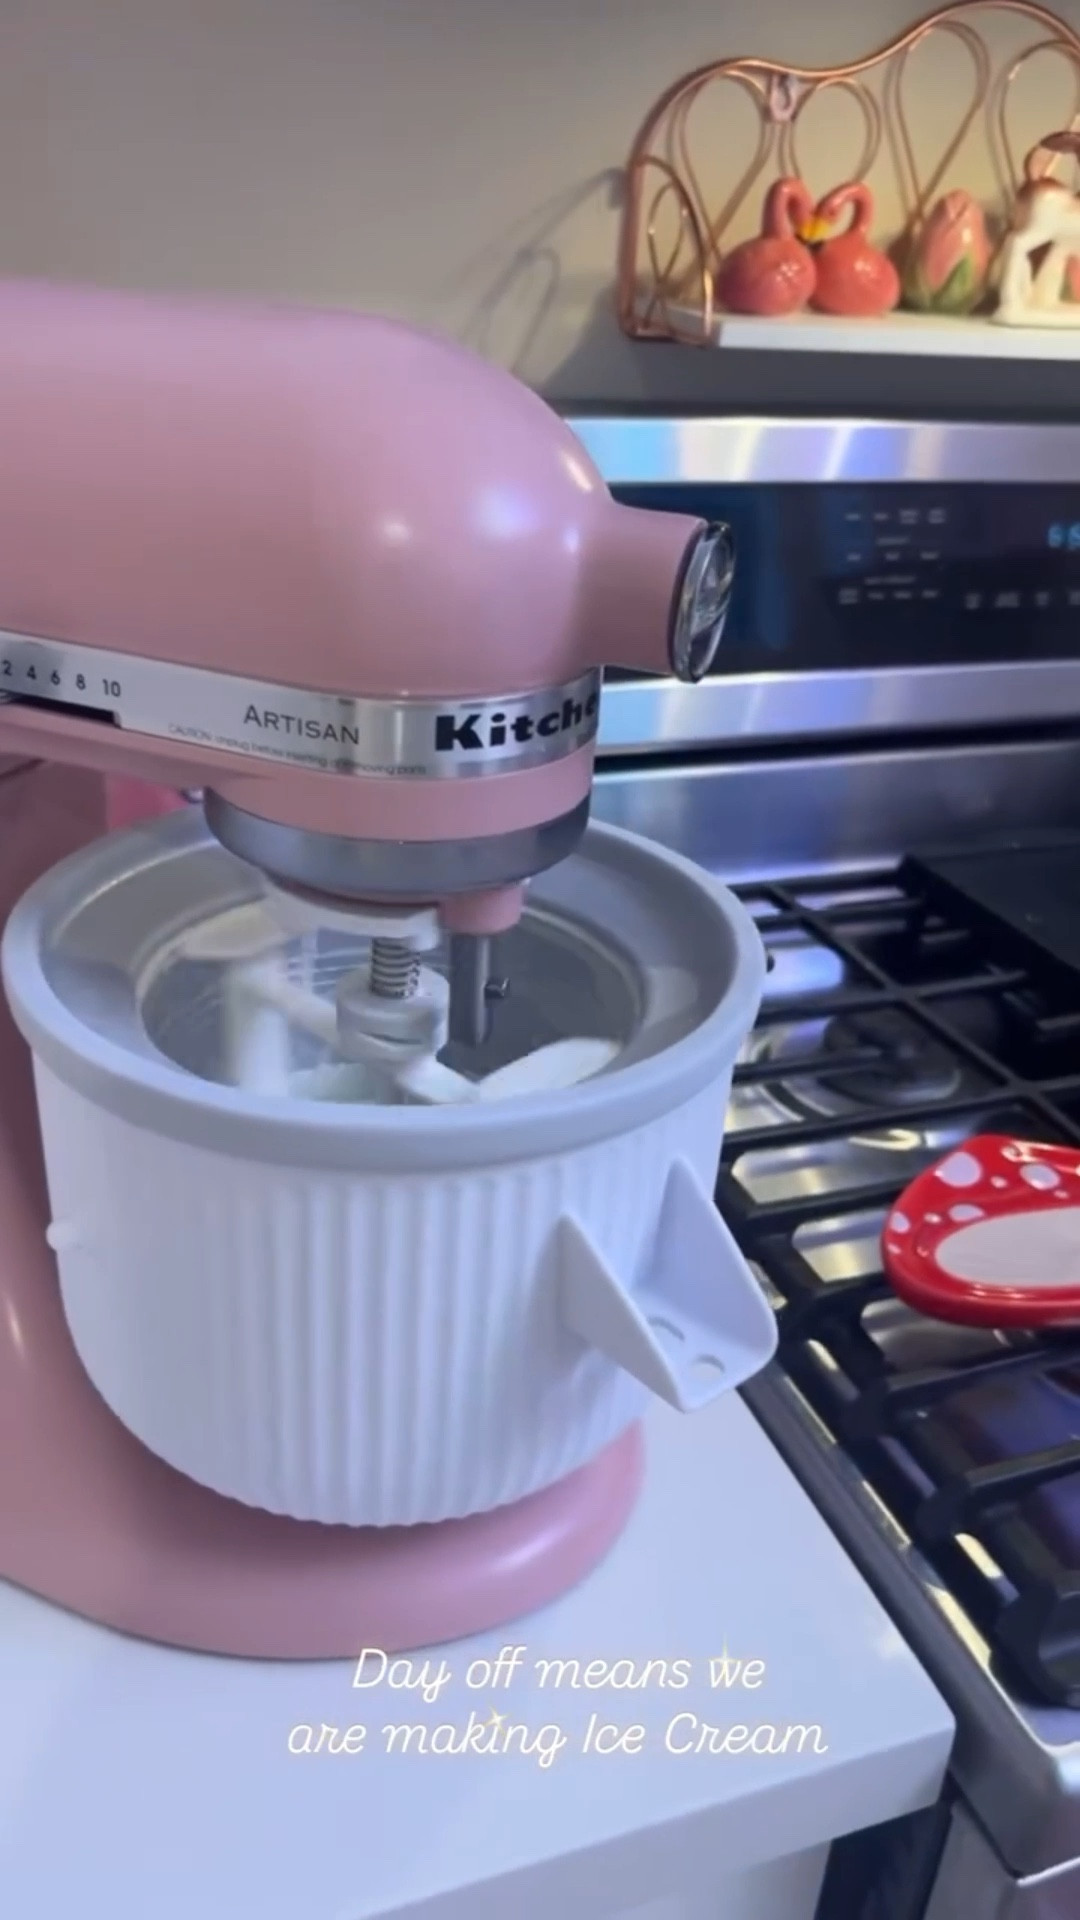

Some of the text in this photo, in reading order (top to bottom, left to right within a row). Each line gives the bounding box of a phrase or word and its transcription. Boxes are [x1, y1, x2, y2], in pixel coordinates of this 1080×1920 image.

[2, 659, 122, 698] 2 4 6 8 10
[243, 704, 360, 746] ARTISAN
